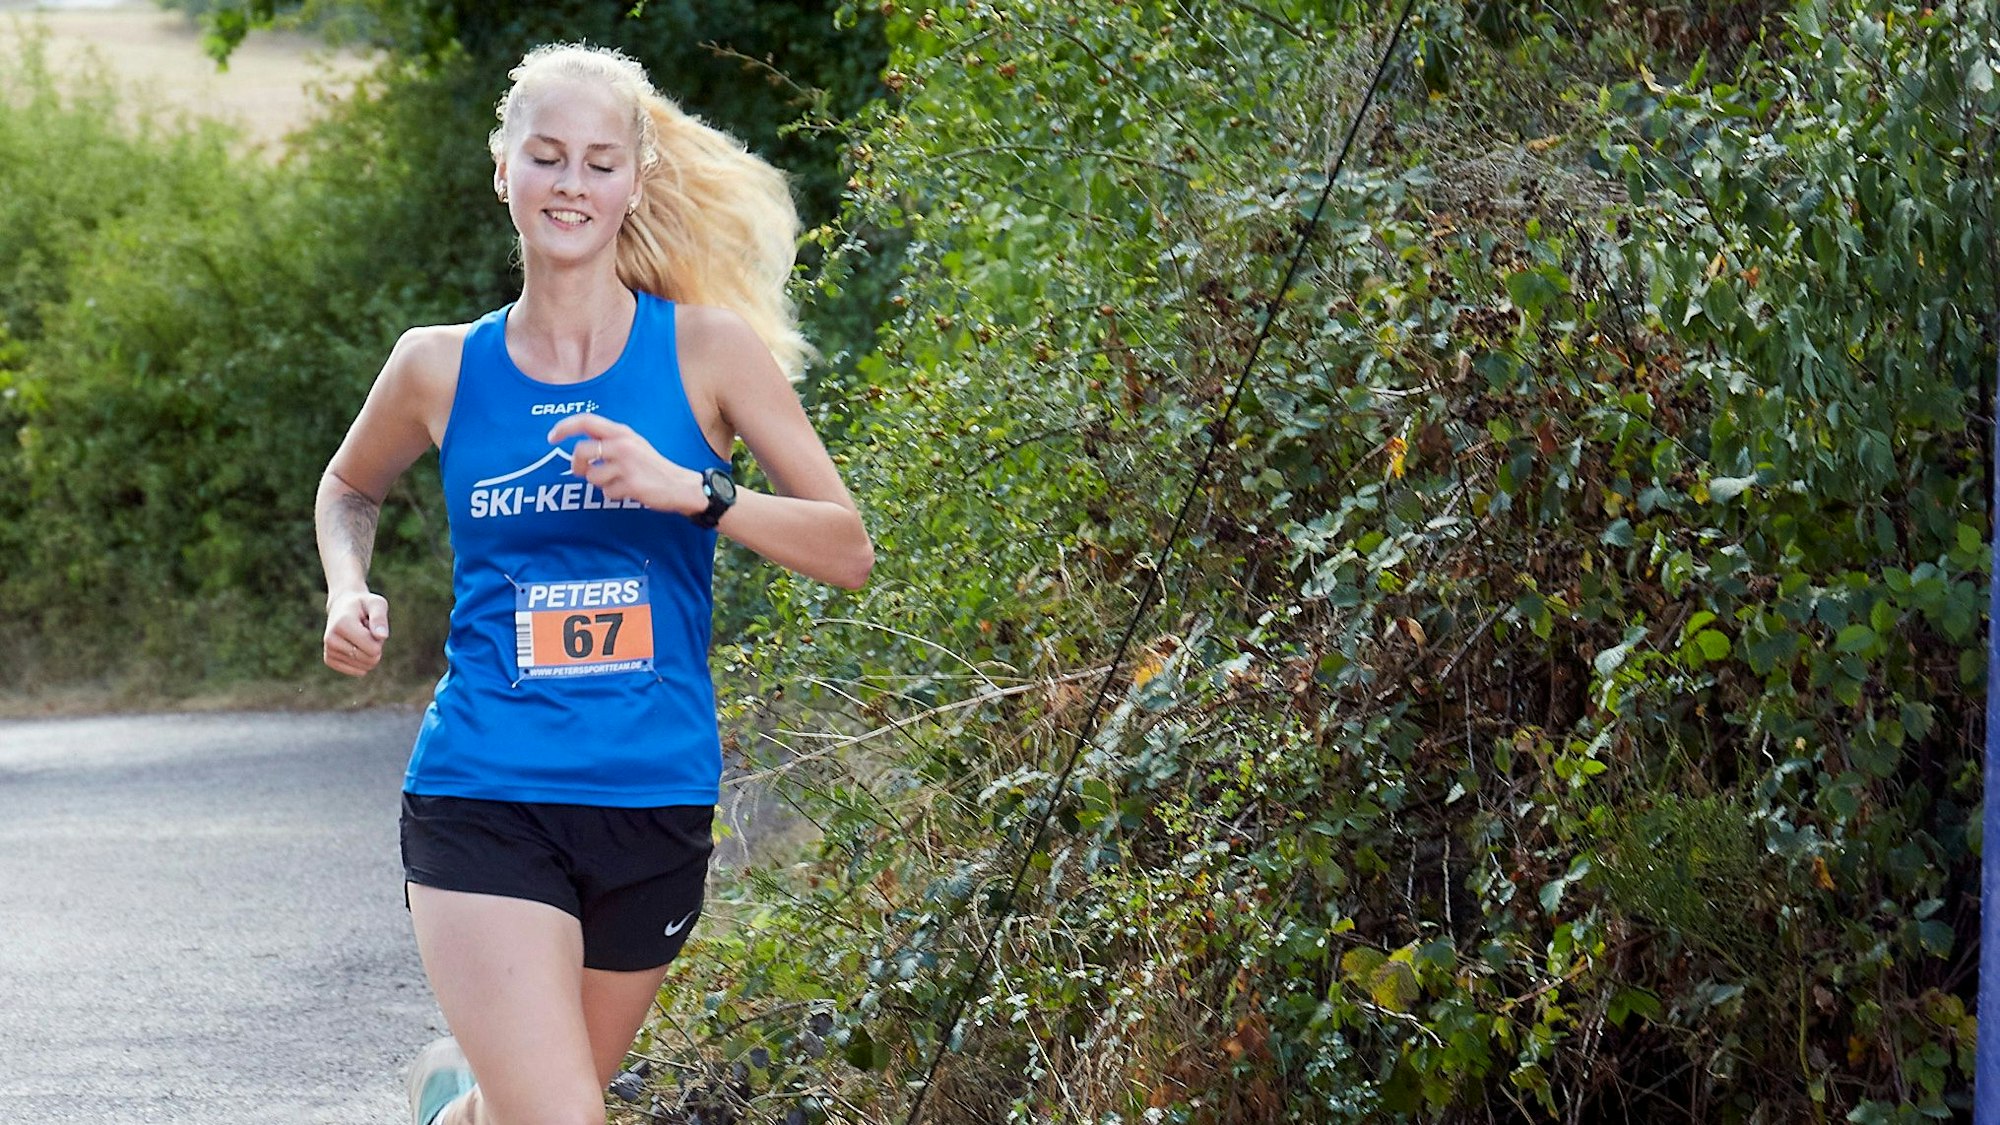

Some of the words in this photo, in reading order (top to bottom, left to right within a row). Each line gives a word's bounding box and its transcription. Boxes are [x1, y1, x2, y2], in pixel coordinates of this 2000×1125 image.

[531, 401, 585, 415] CRAFT
[470, 483, 651, 518] SKI-KEL
[528, 580, 640, 608] PETERS
[563, 613, 623, 658] 67
[530, 661, 642, 676] WWW.PETERSSPORTTEAM.DE
